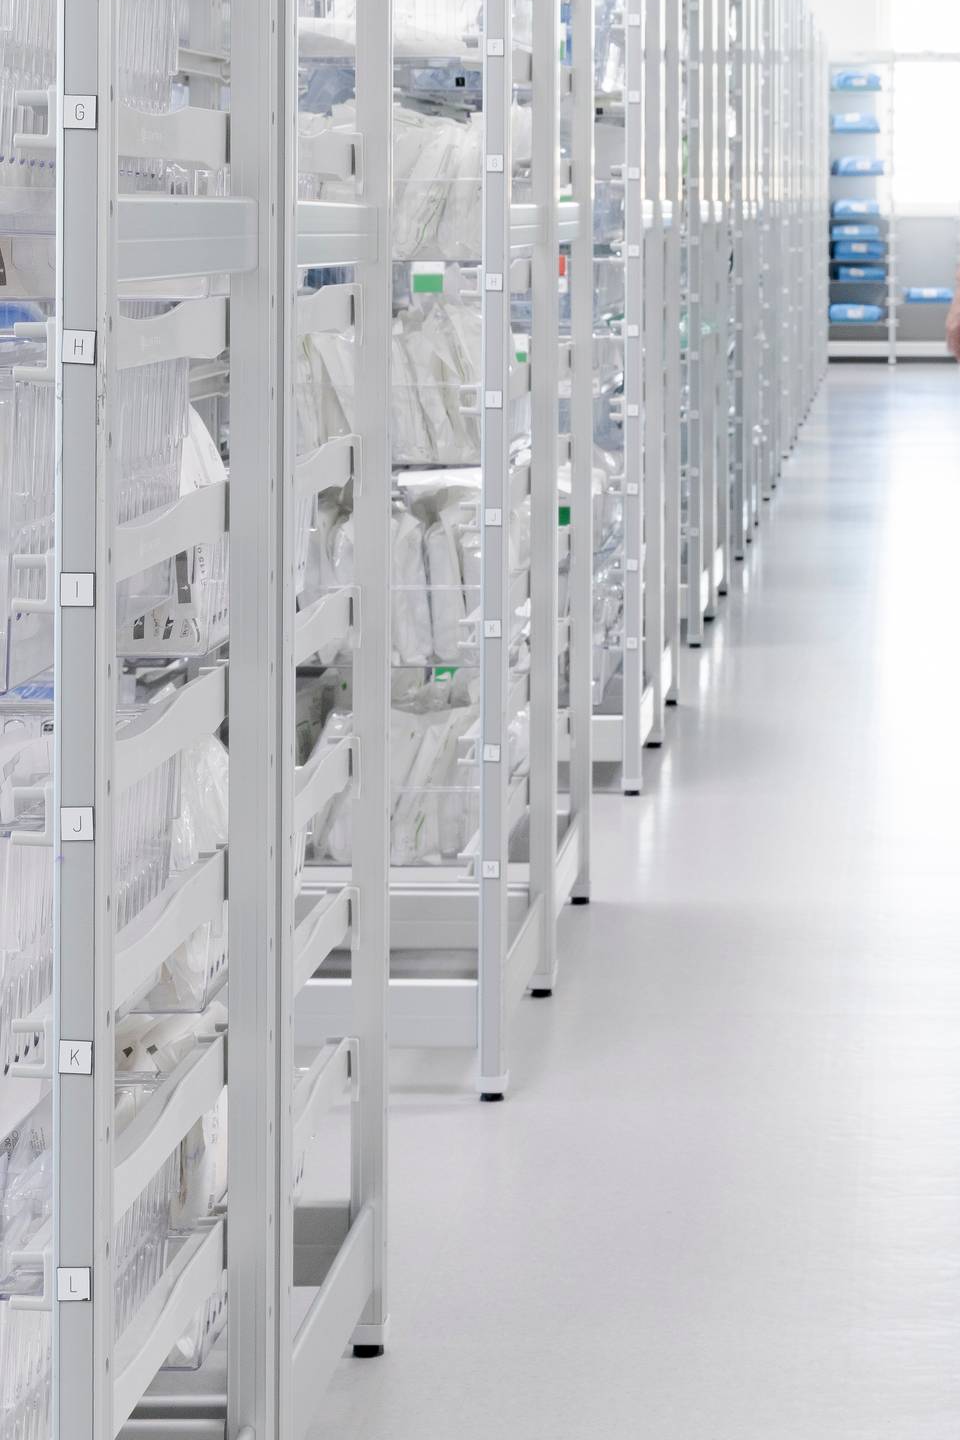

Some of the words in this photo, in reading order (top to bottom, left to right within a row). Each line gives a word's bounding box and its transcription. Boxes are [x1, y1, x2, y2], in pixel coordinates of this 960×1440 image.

[75, 104, 84, 120] G
[74, 338, 84, 356] H
[73, 816, 81, 832] J
[71, 1049, 80, 1066] K
[70, 1276, 77, 1292] L
